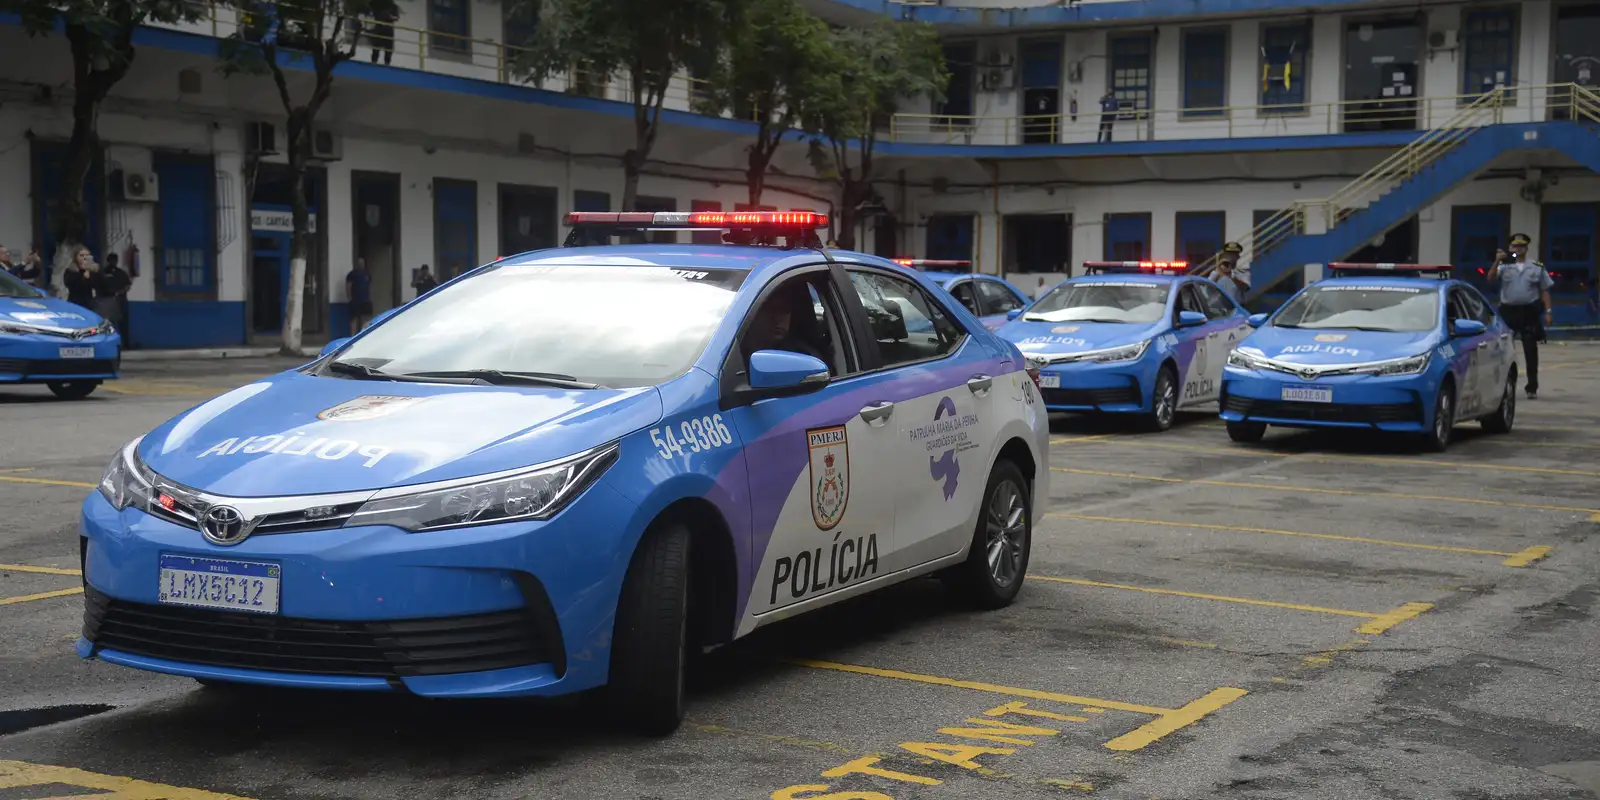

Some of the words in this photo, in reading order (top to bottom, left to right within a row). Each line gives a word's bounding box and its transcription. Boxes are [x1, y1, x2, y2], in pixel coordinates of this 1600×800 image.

[649, 413, 732, 460] 54-9386
[810, 430, 844, 446] PMERJ
[909, 423, 937, 442] PATRULHA
[937, 419, 954, 435] MARIA
[954, 417, 963, 430] DA
[962, 413, 979, 428] PENHA
[770, 531, 878, 605] POLÍCIA
[170, 571, 264, 606] LMX5C12
